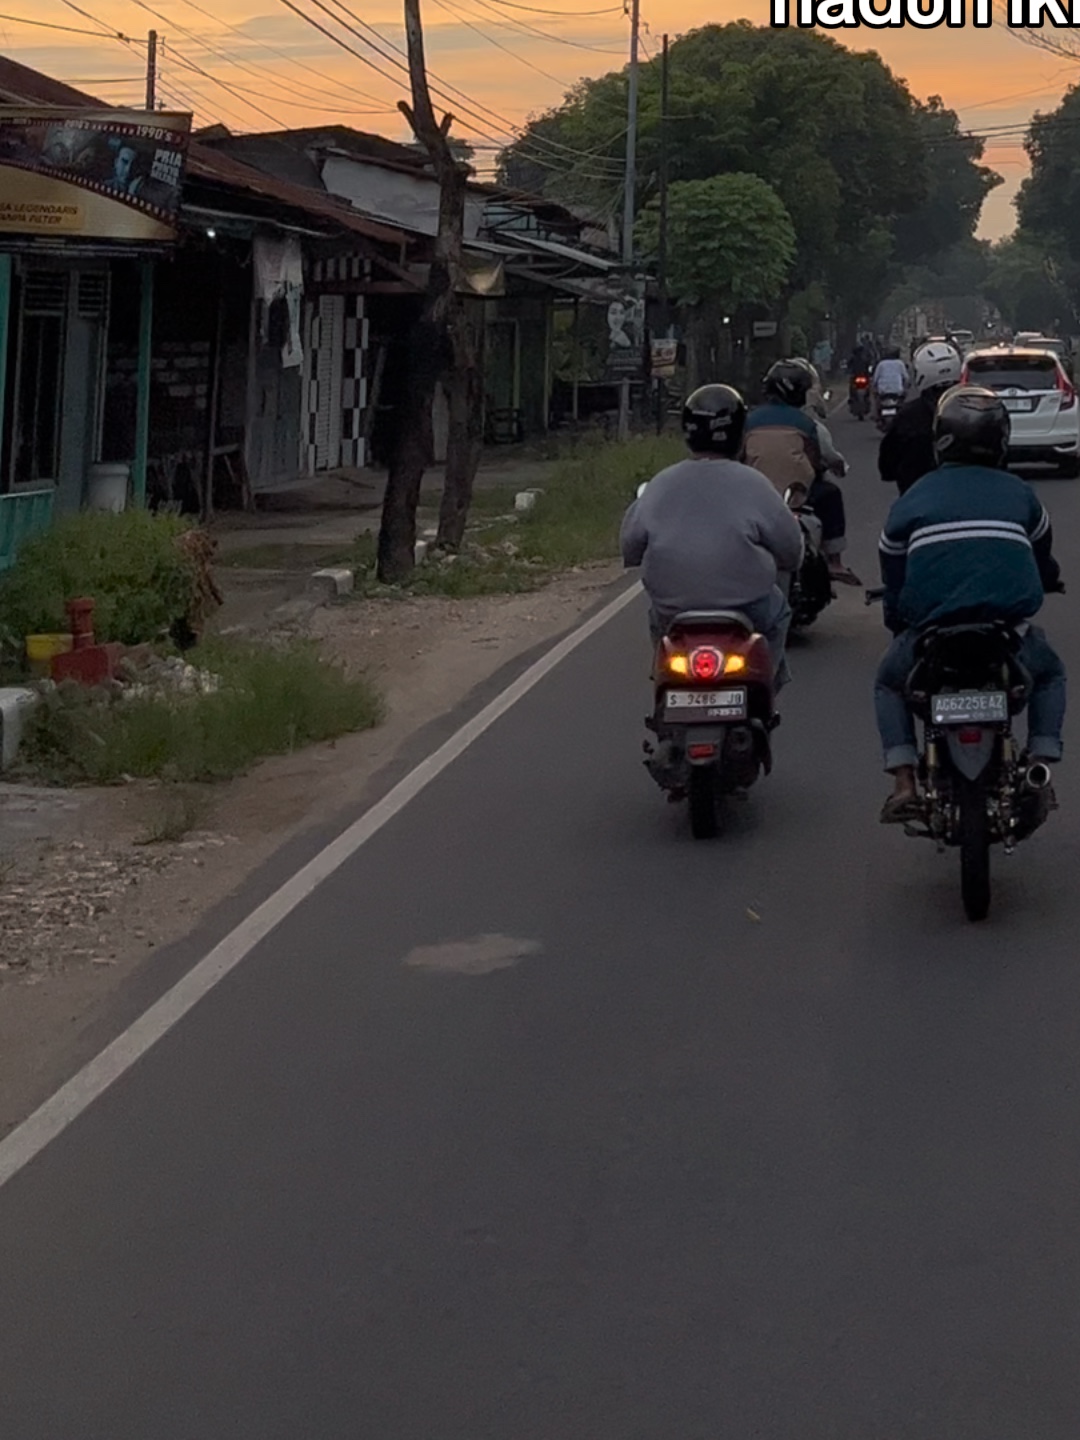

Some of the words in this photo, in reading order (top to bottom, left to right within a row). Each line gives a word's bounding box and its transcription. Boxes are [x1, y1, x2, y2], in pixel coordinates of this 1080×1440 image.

[136, 125, 173, 141] 1990's
[154, 148, 182, 167] PRIA
[669, 694, 677, 705] S
